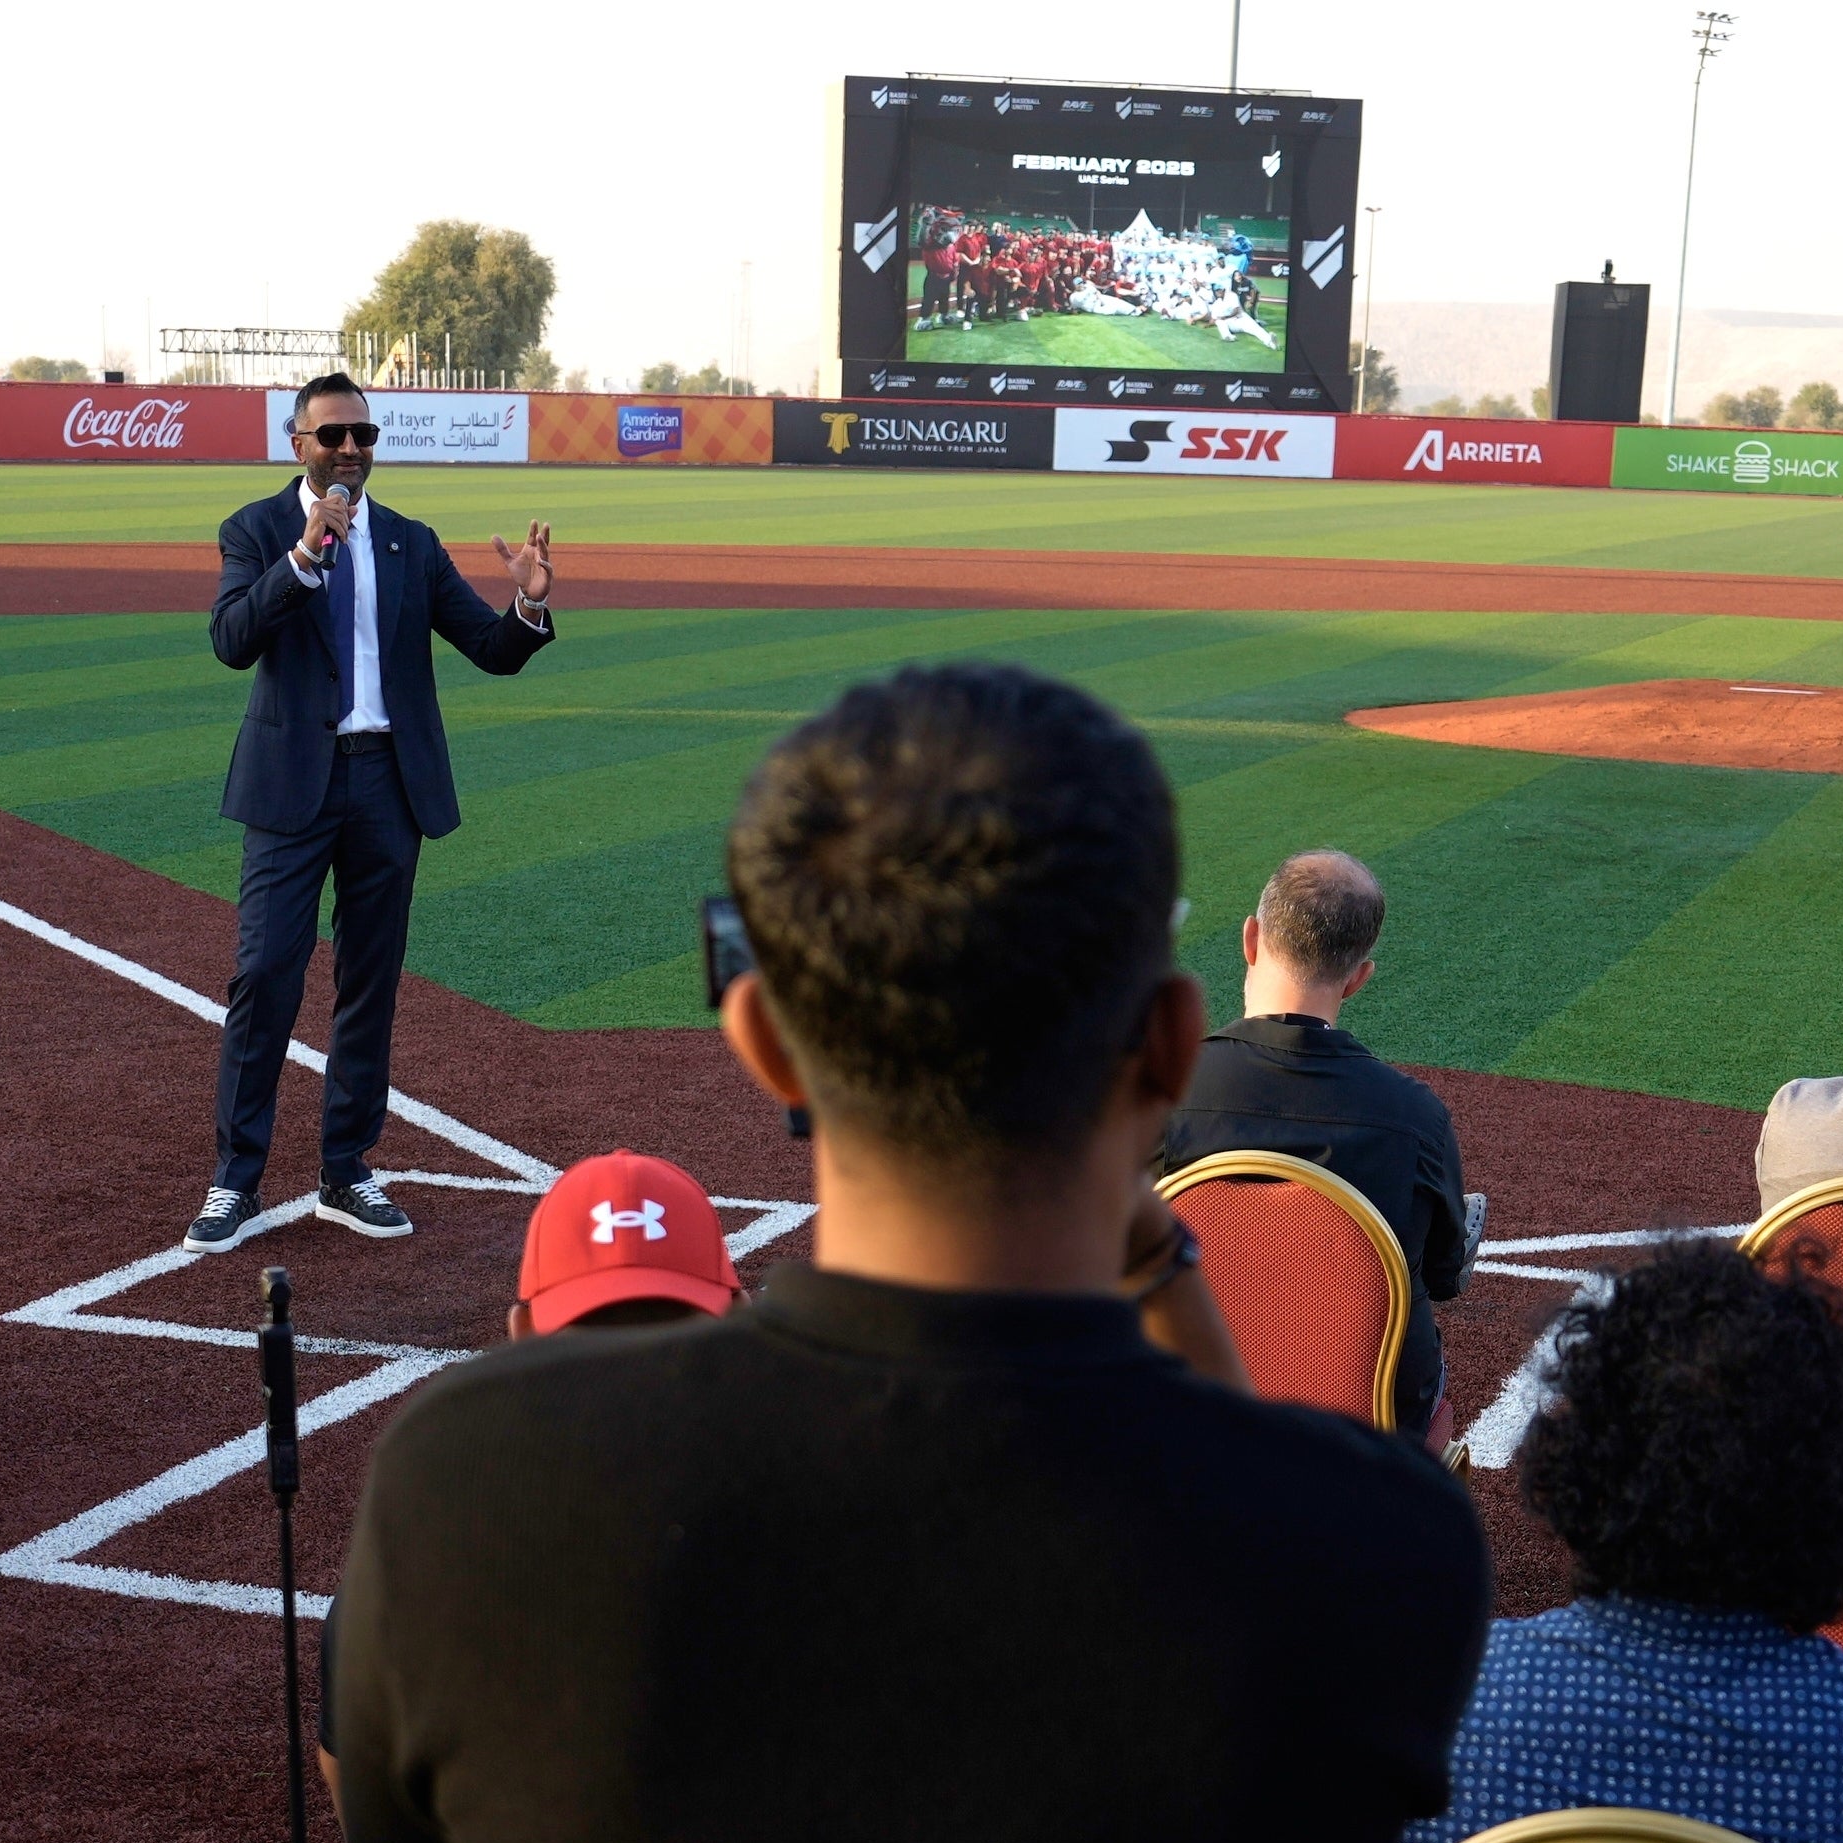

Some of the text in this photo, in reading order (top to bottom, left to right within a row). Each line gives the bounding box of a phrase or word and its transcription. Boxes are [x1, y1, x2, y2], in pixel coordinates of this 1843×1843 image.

[1012, 154, 1195, 176] FEBRUARY 2025
[1078, 174, 1130, 185] UAE Series
[63, 398, 191, 448] Coca-Cola
[383, 410, 436, 431] al tayer
[623, 412, 679, 427] American
[860, 418, 1007, 443] TSUNAGARU
[387, 433, 436, 447] motors
[622, 426, 666, 442] Garden
[1179, 427, 1289, 461] SSK
[1446, 441, 1542, 463] ARRIETA
[1666, 454, 1839, 478] SHAKE SHACK
